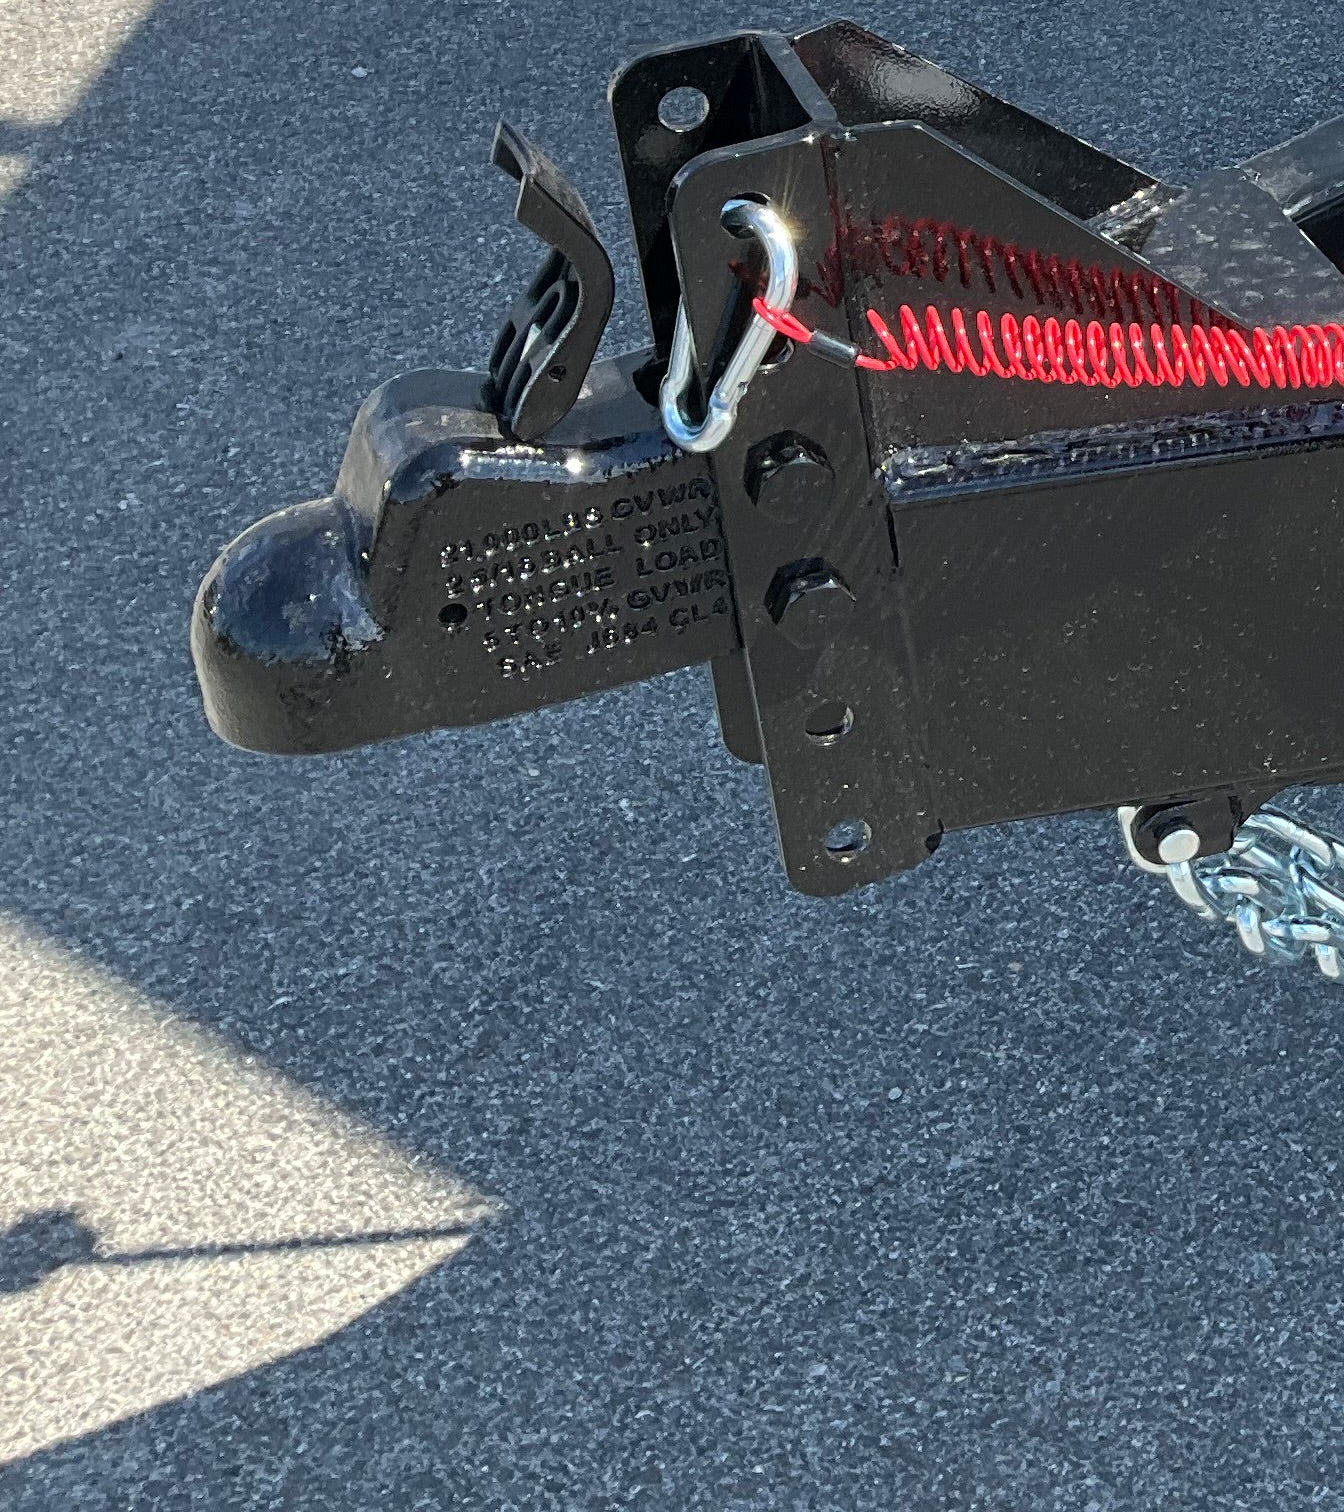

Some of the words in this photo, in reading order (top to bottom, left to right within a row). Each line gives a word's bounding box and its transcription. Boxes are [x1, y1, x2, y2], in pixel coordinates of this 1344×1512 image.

[611, 477, 712, 521] GVWR
[634, 504, 718, 547] ONLY
[476, 566, 616, 621] TONGUE
[635, 538, 723, 579] LOAD
[626, 568, 728, 610] GVWR
